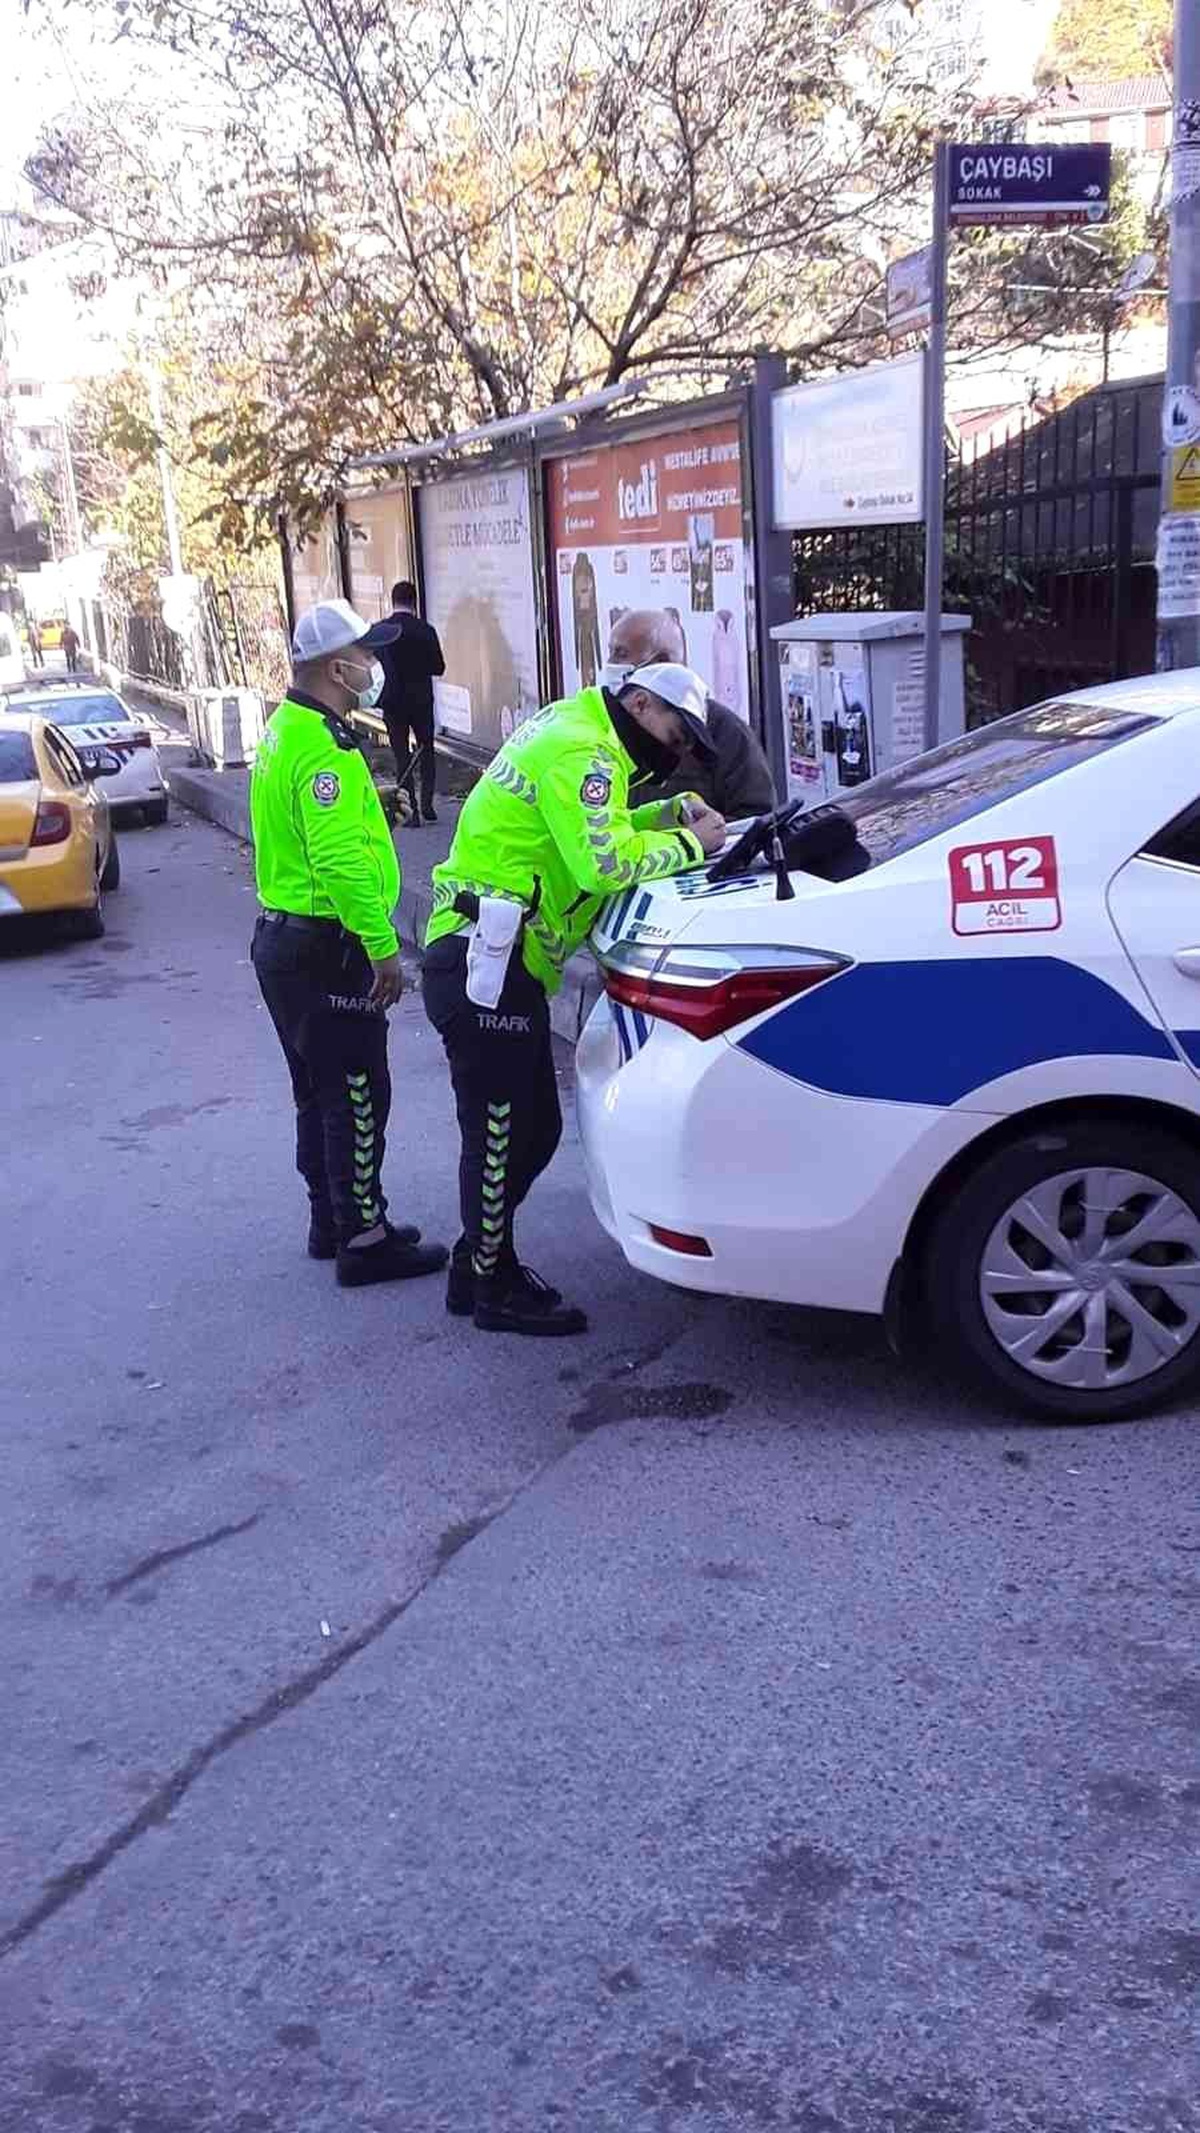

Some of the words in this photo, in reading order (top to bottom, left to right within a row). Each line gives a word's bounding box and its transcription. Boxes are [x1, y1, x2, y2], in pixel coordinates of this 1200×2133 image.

[960, 157, 1053, 182] ÇAYBAŞI
[958, 186, 1002, 199] SOKAK
[962, 847, 1045, 892] 112
